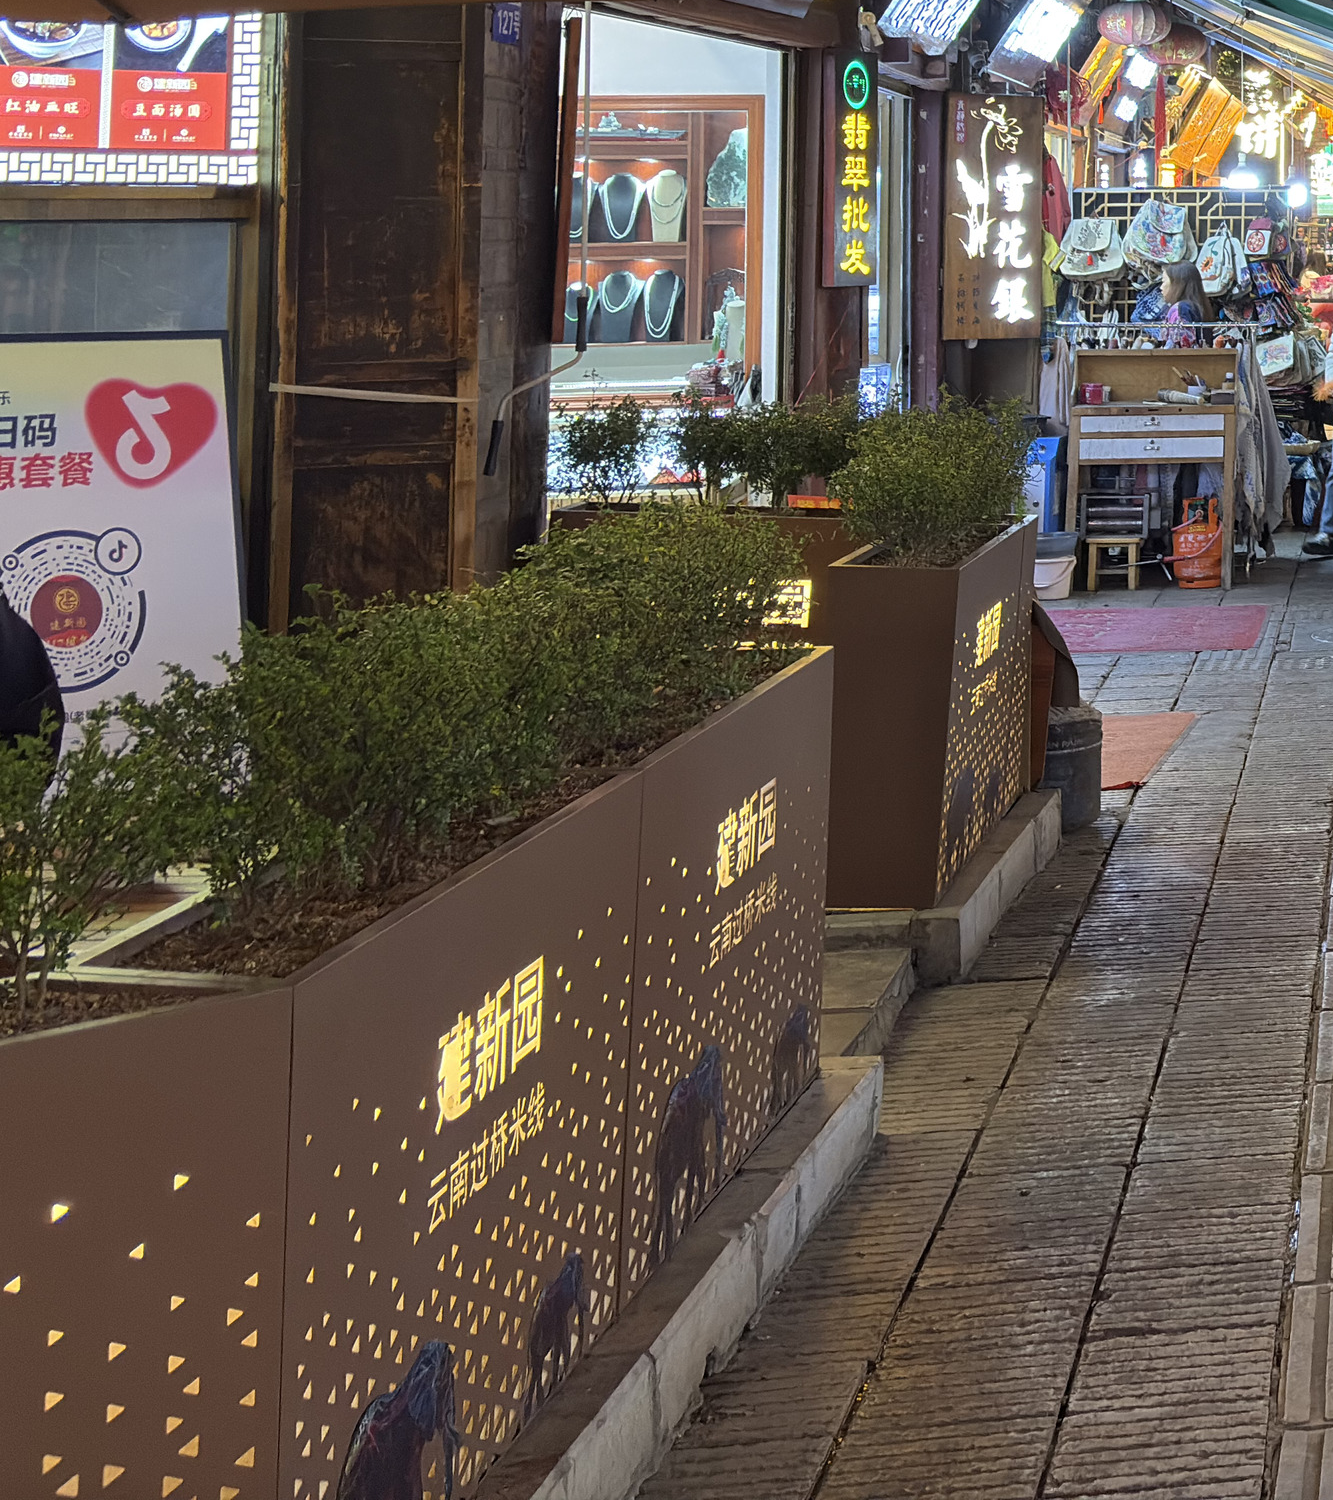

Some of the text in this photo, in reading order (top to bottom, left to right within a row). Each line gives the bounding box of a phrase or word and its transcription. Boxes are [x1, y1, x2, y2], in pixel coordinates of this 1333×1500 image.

[497, 9, 520, 40] 127号
[840, 111, 871, 275] 翡翠批发
[991, 163, 1035, 325] 雪花银
[716, 776, 778, 896] 建新园
[709, 872, 779, 970] 云南过桥米线
[435, 954, 545, 1135] 建新园
[427, 1081, 546, 1235] 云南过桥米线
